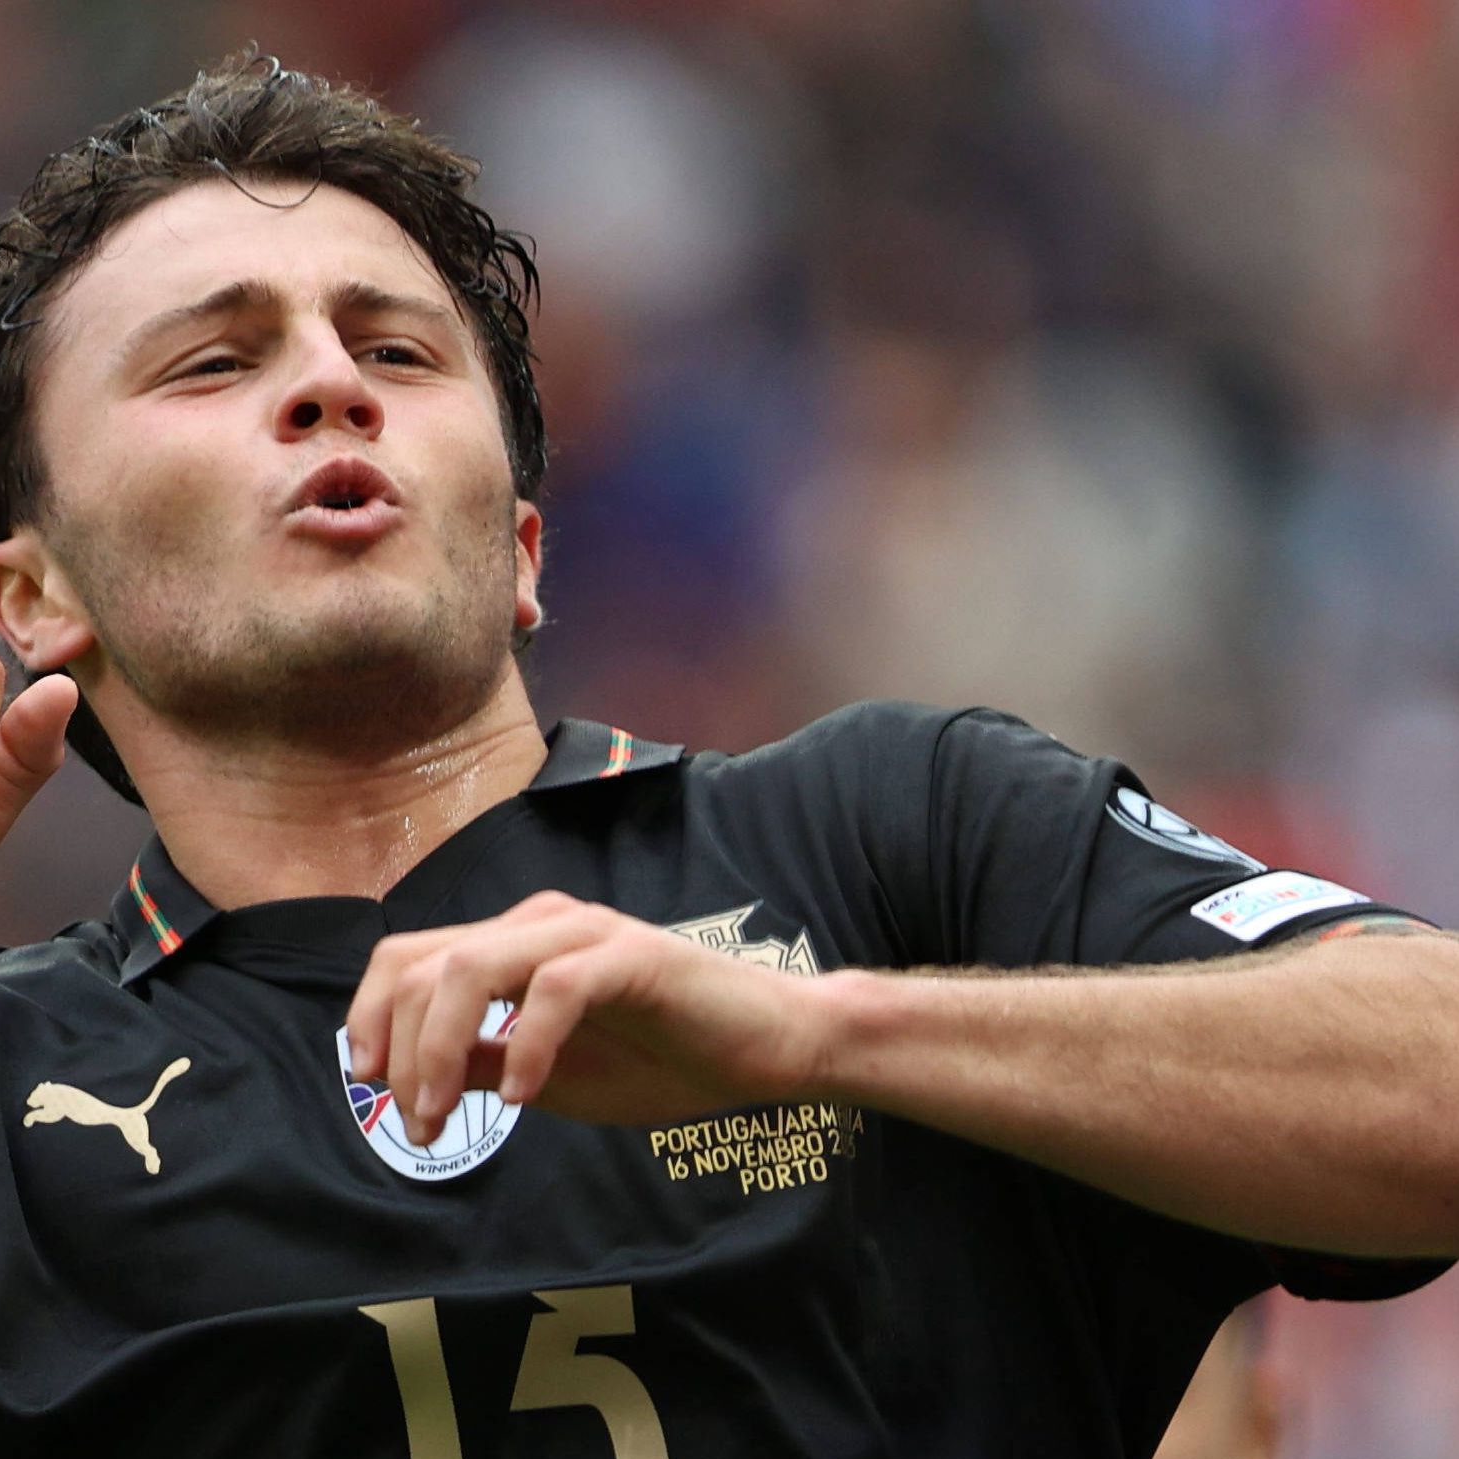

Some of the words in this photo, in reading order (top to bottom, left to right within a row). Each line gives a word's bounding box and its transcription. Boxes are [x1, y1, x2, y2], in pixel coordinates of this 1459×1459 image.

[414, 1154, 472, 1174] WINNER
[473, 1128, 504, 1159] 2025
[666, 1155, 690, 1182] 16
[693, 1131, 825, 1178] NOVEMBRO
[739, 1156, 829, 1196] PORTO
